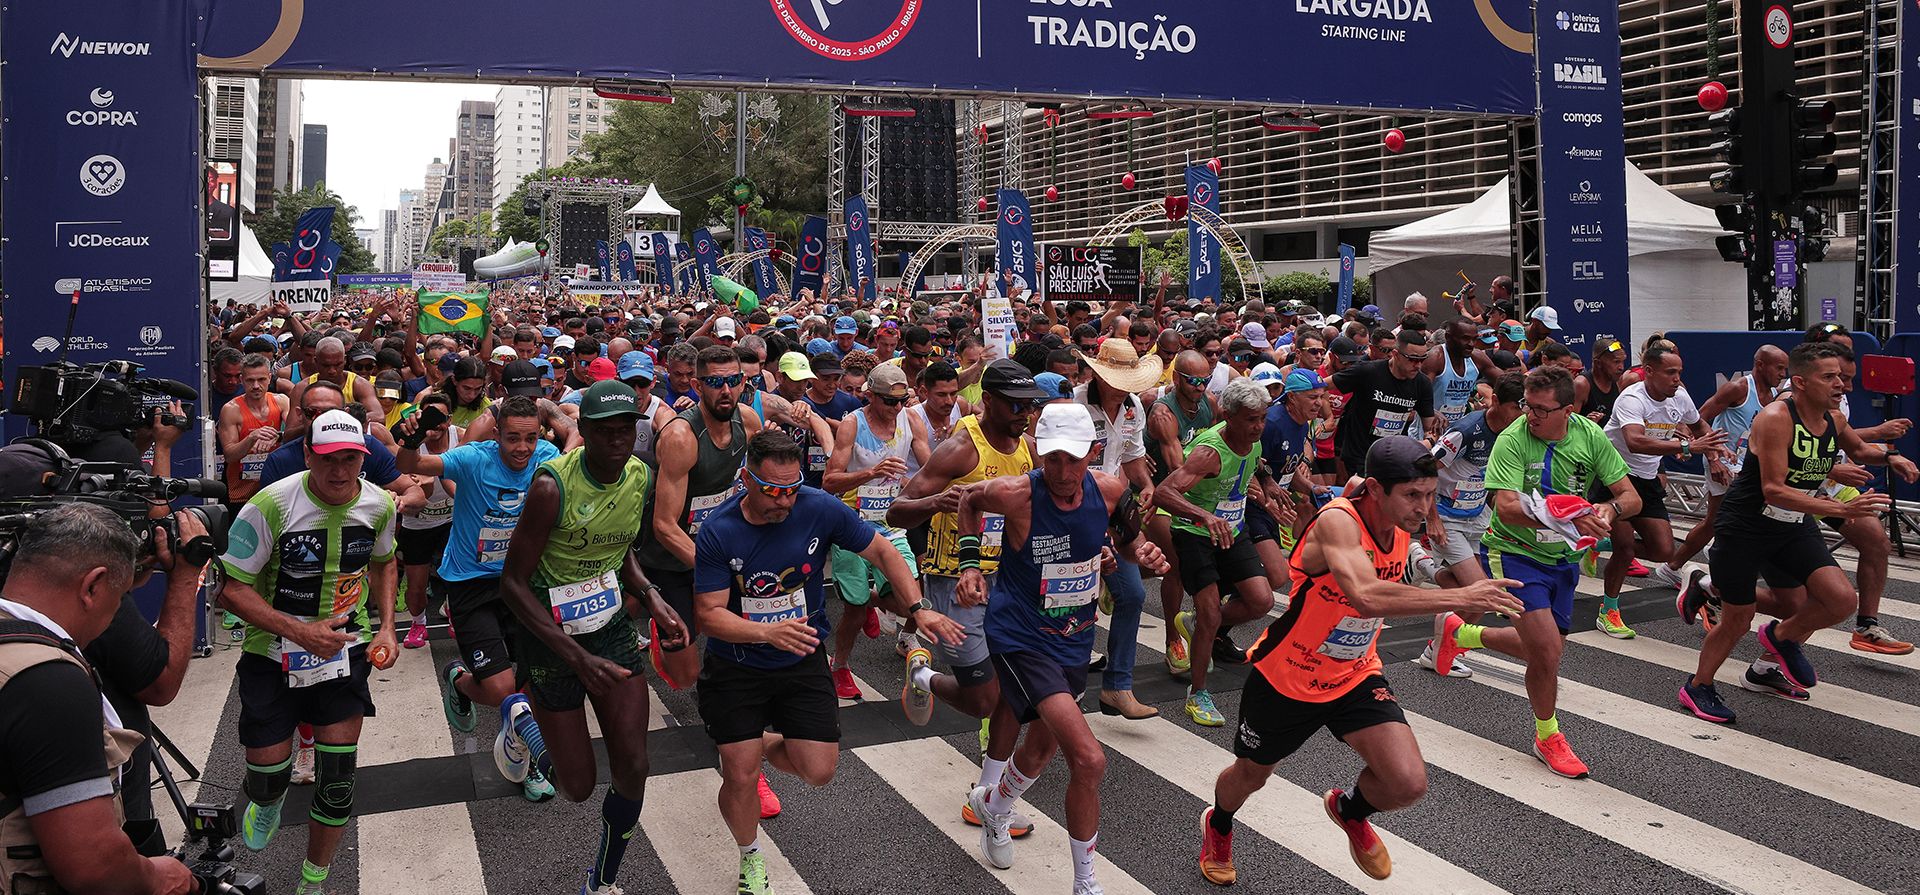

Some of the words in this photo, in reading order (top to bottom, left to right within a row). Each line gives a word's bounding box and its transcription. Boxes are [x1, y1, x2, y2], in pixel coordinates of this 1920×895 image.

[1571, 12, 1600, 24] loterias
[781, 10, 818, 47] DEZEMBRO
[818, 42, 830, 53] DE
[831, 47, 851, 56] 2025
[858, 45, 876, 56] SÃO
[876, 29, 900, 50] PAULO
[900, 0, 918, 27] BRASIL
[1321, 25, 1378, 41] STARTING
[1381, 29, 1406, 42] LINE
[1572, 22, 1601, 33] CAIXA
[1027, 14, 1196, 60] TRADIÇÃO
[80, 42, 150, 55] NEWON
[1554, 63, 1607, 84] BRASIL
[66, 110, 137, 127] COPRA
[69, 234, 150, 247] JCDecaux
[640, 236, 650, 250] 3
[1012, 240, 1024, 273] asics
[421, 263, 453, 272] CERQUILHO
[1049, 263, 1069, 280] SÃO
[1072, 263, 1093, 280] LUÍS
[1572, 261, 1604, 277] FCL
[84, 278, 152, 286] ATLETISMO
[1049, 280, 1093, 293] PRESENTE
[84, 285, 128, 293] BRASIL
[272, 287, 329, 304] LORENZO
[1585, 301, 1605, 309] VEGA
[1373, 389, 1418, 408] Racionais
[1803, 457, 1832, 473] GAN
[867, 500, 890, 508] 7056
[284, 535, 322, 551] ICEBERG
[1032, 535, 1070, 548] RESTAURANTE
[1032, 547, 1052, 556] RECANTO
[1053, 543, 1071, 553] PAULISTA
[578, 560, 602, 569] FISIO
[1033, 555, 1041, 564] SÃO
[1042, 553, 1054, 563] PAULO
[1058, 576, 1092, 591] 5787
[572, 595, 608, 617] 7135
[1338, 632, 1370, 645] 4506
